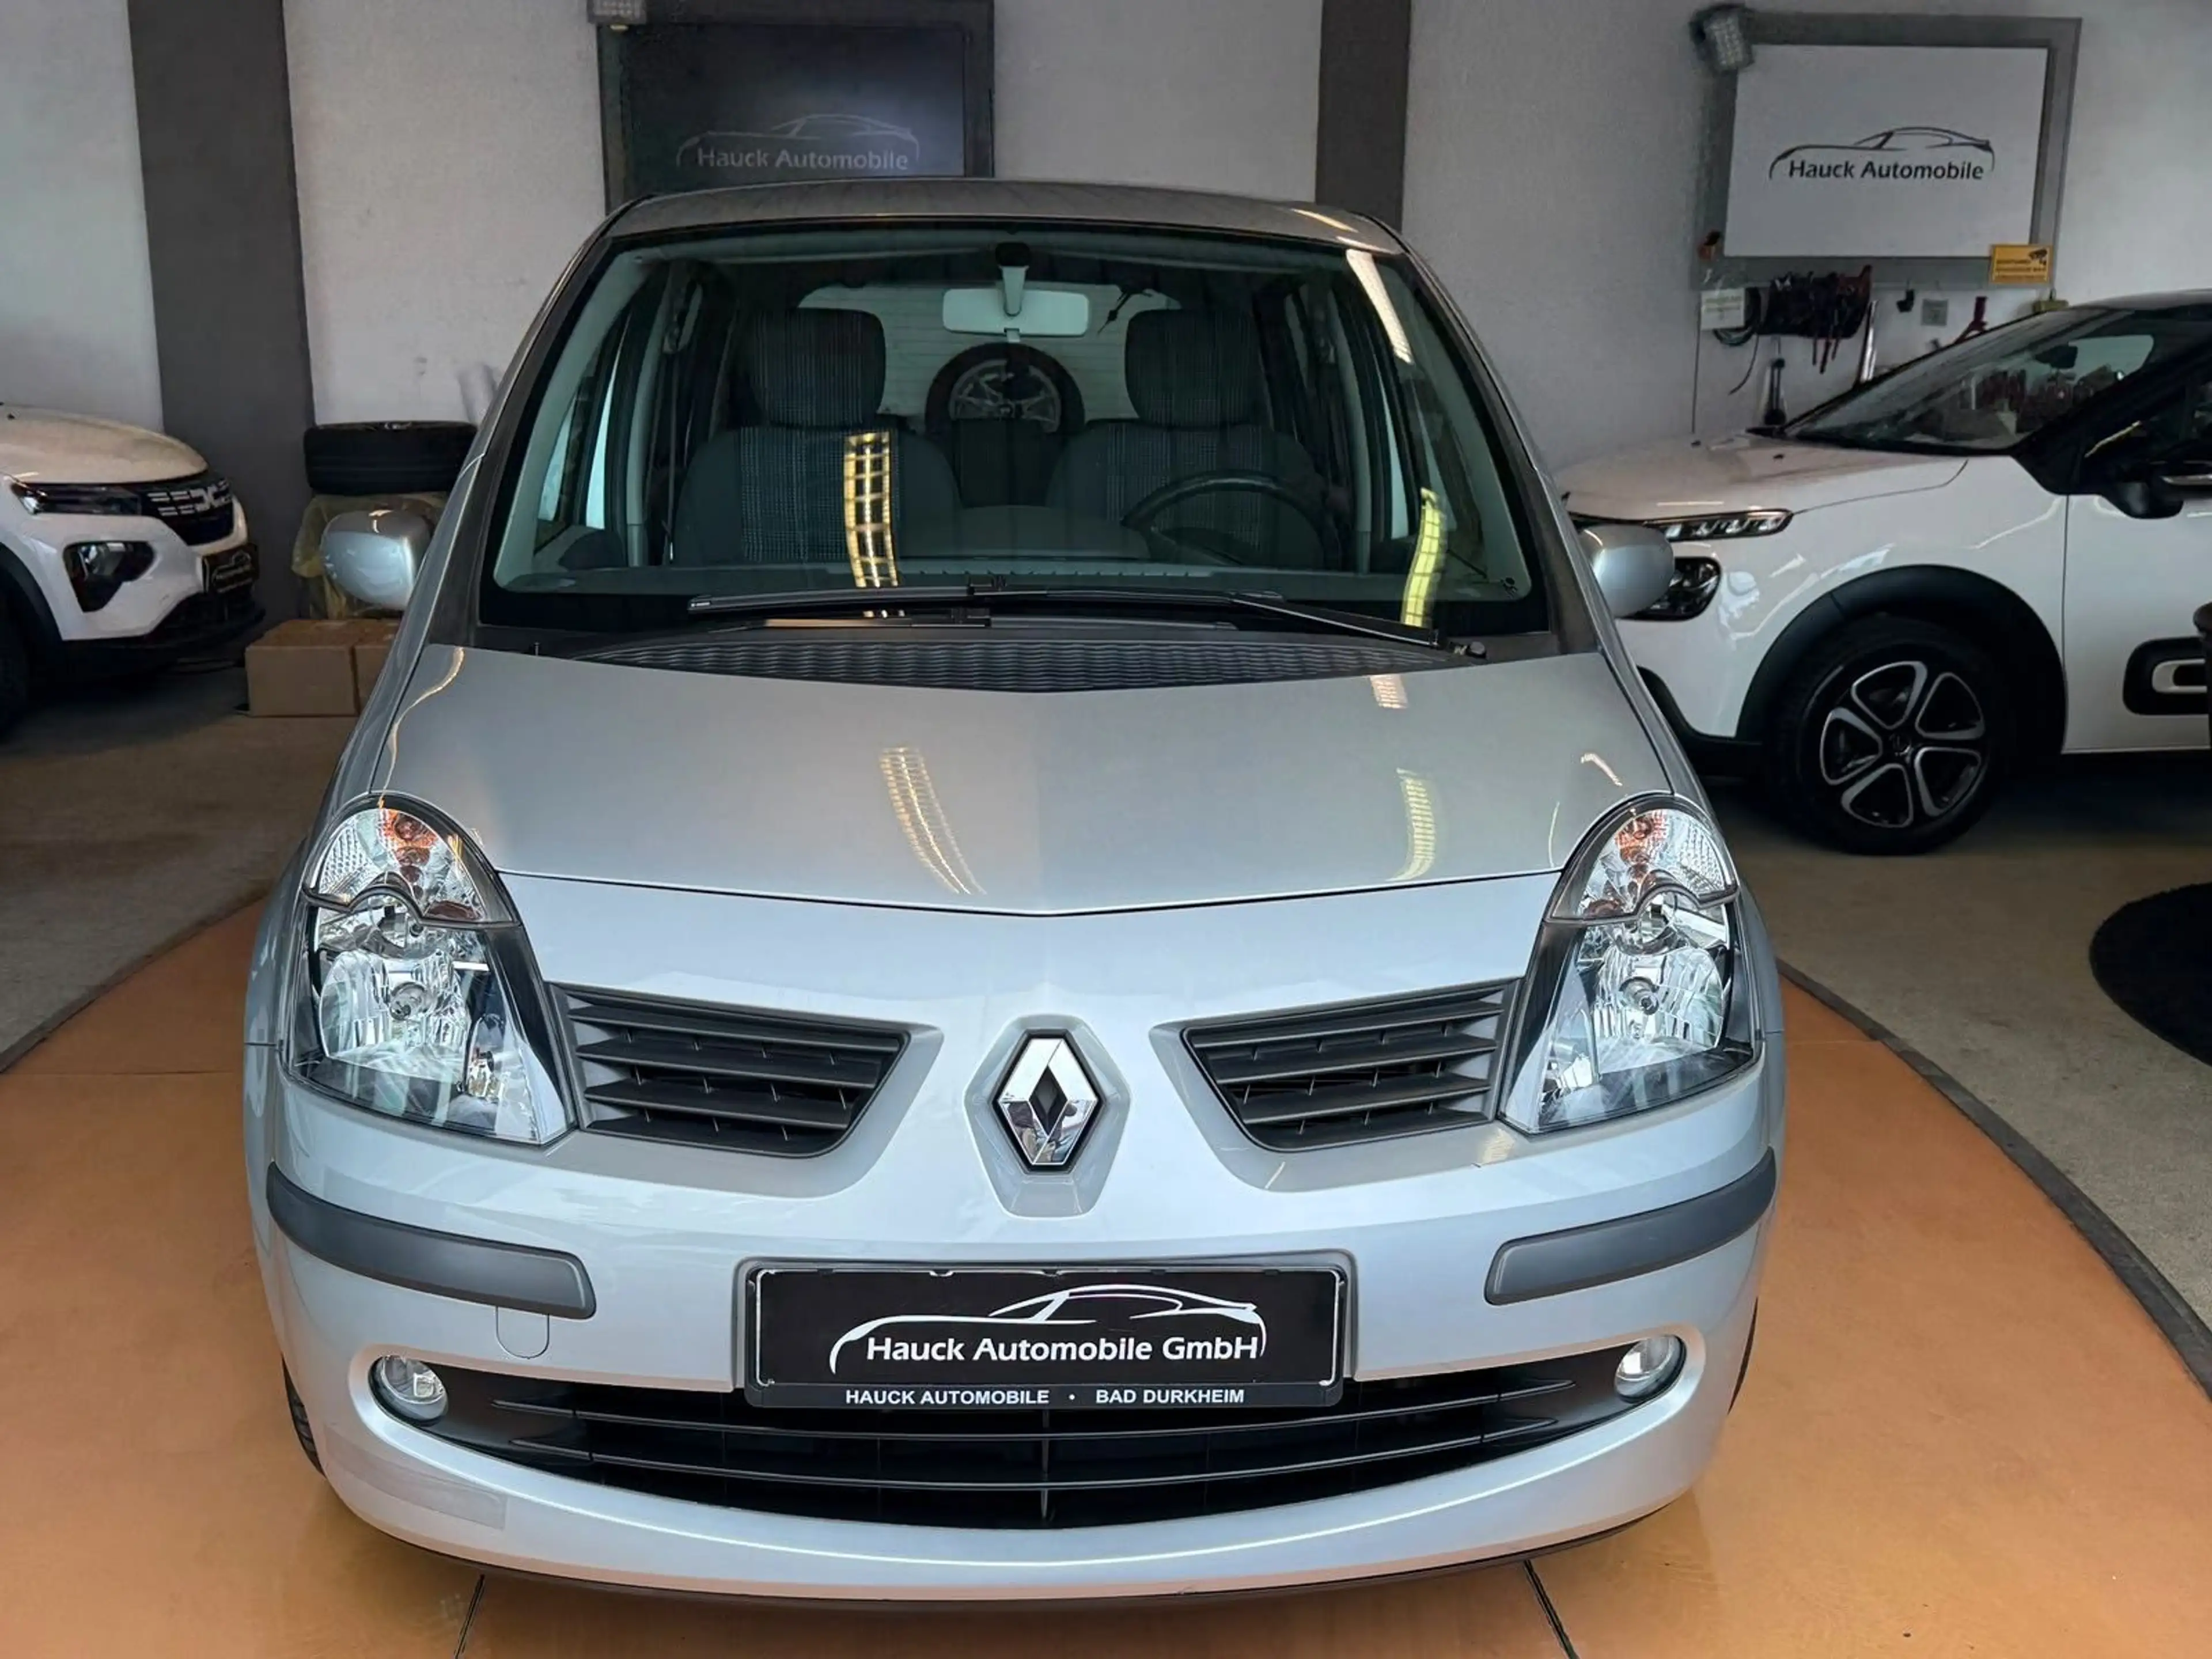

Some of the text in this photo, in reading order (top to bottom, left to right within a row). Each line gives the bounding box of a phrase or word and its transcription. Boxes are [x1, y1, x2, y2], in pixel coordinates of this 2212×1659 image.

[697, 147, 908, 171] Hauck Automobile
[1789, 160, 1984, 180] Hauck Automobile
[866, 1336, 1258, 1361] Hauck Automobile GmbH
[846, 1389, 1245, 1404] HAUCK AUTOMOBILE BAD DURKHEIM
